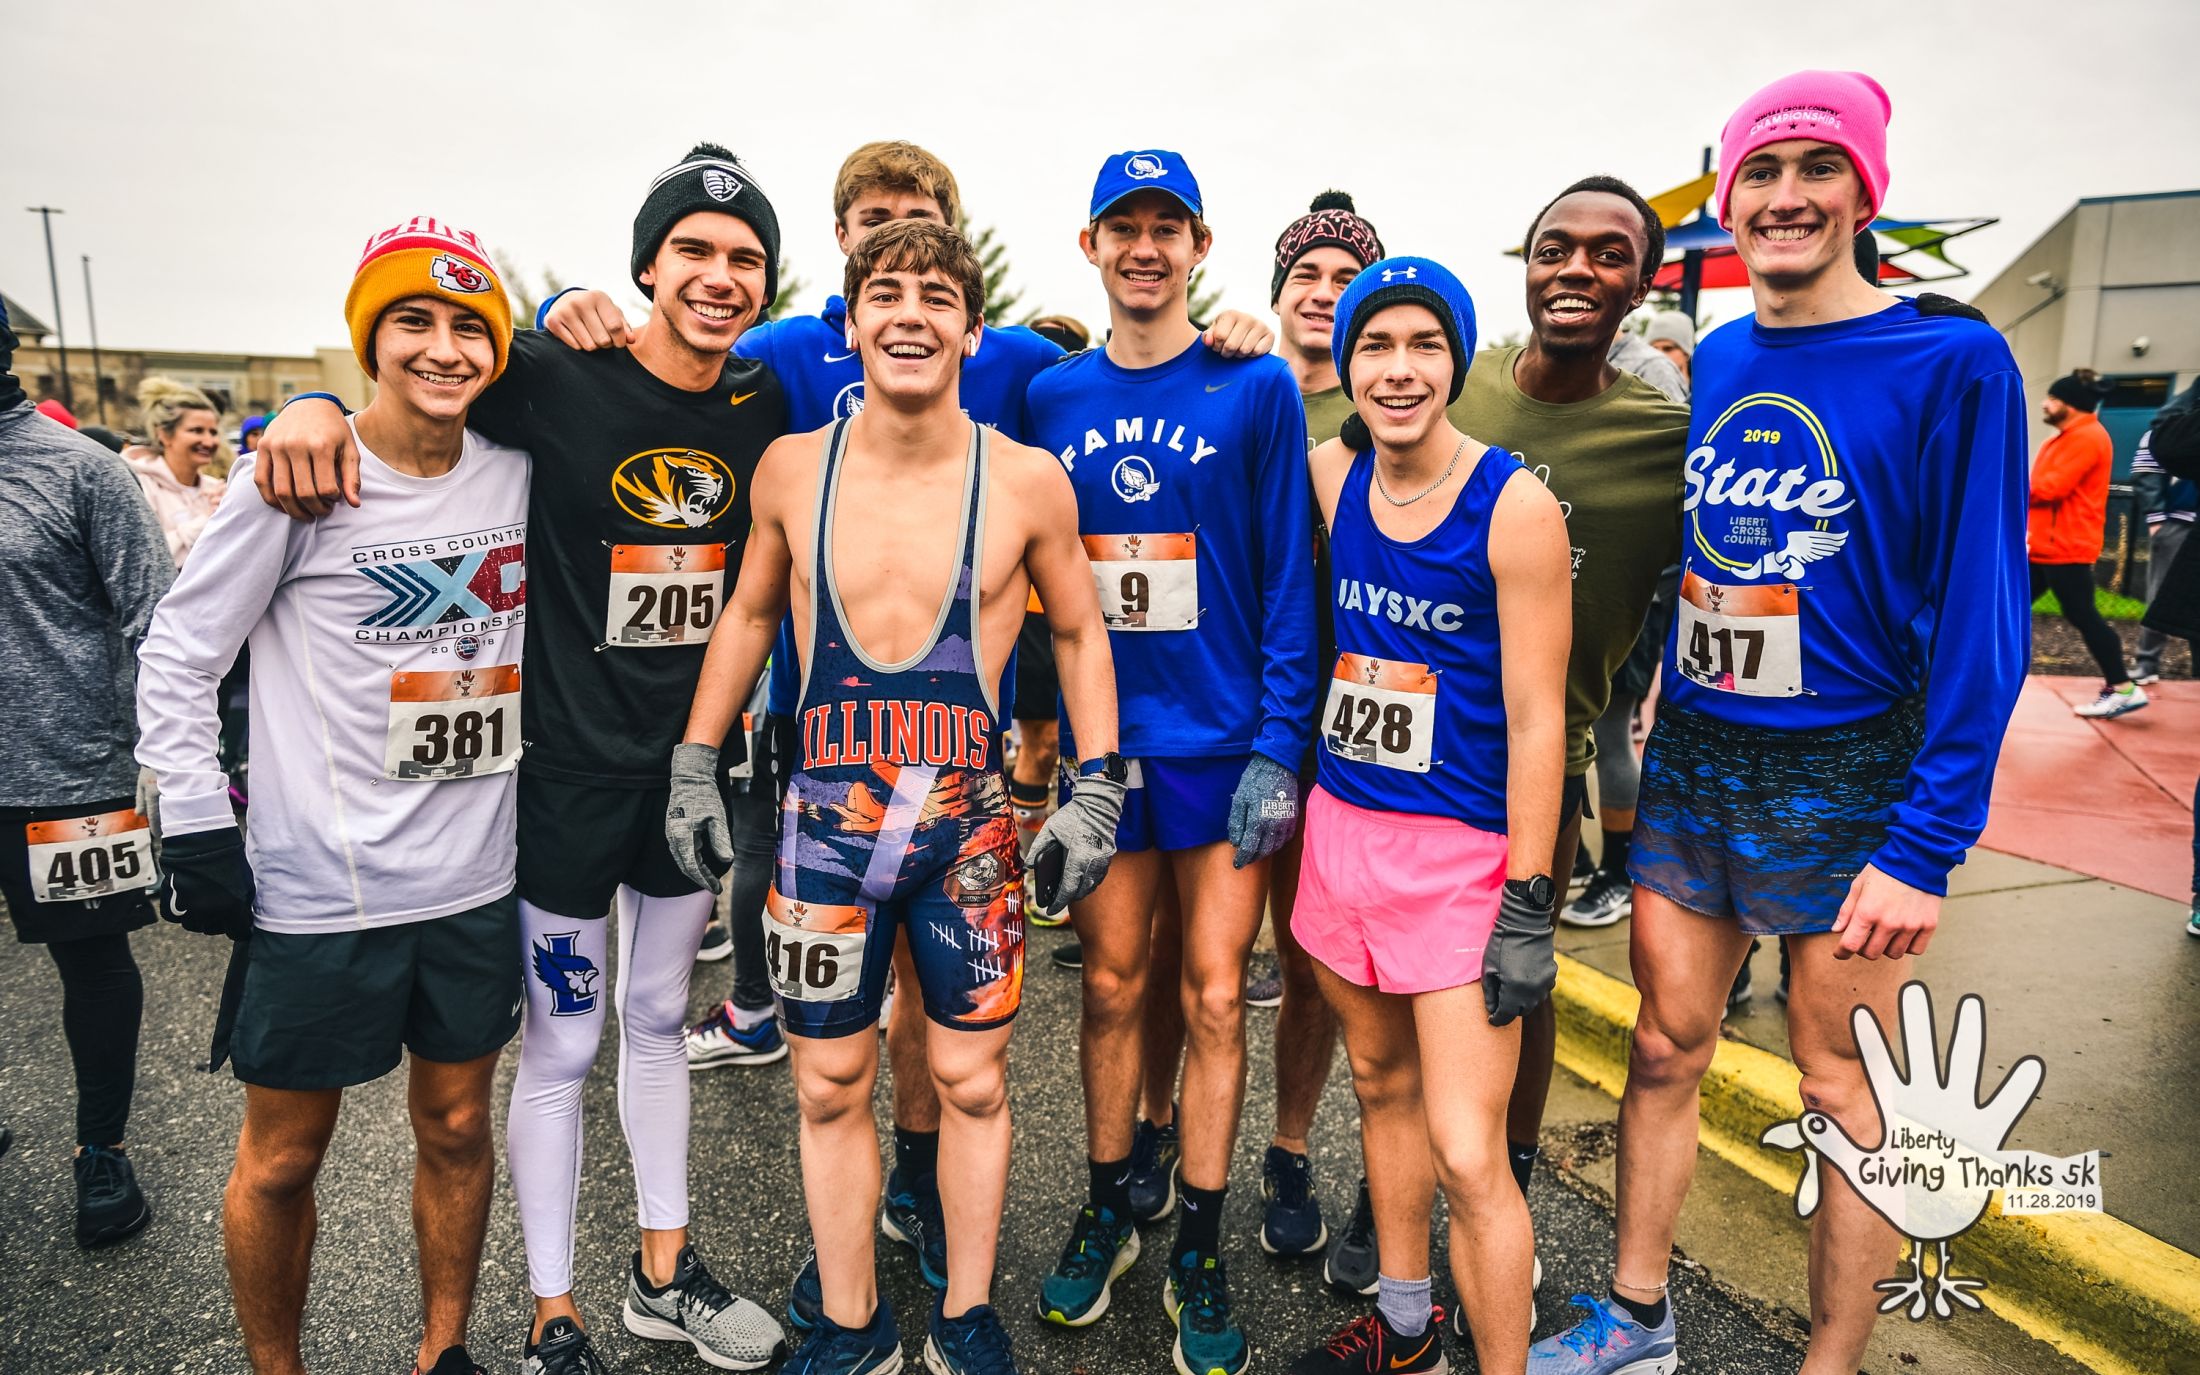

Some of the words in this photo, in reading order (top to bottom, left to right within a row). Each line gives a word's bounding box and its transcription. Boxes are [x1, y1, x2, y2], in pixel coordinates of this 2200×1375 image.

[1749, 111, 1841, 135] CHAMPIONSHIPS
[1807, 105, 1839, 116] COUNTRY
[1059, 417, 1218, 473] FAMILY
[1743, 429, 1781, 444] 2019
[1684, 445, 1856, 517] State
[352, 544, 437, 564] CROSS
[1723, 534, 1773, 547] COUNTRY
[1731, 525, 1768, 537] CROSS
[625, 583, 714, 631] 205
[1120, 572, 1149, 616] 9
[431, 646, 449, 654] 20
[482, 638, 495, 646] 18
[1689, 620, 1765, 680] 417
[412, 707, 504, 766] 381
[803, 700, 990, 770] ILLINOIS
[1332, 694, 1413, 754] 428
[1262, 801, 1295, 810] LIBERTY
[47, 840, 141, 888] 405
[766, 931, 840, 989] 416
